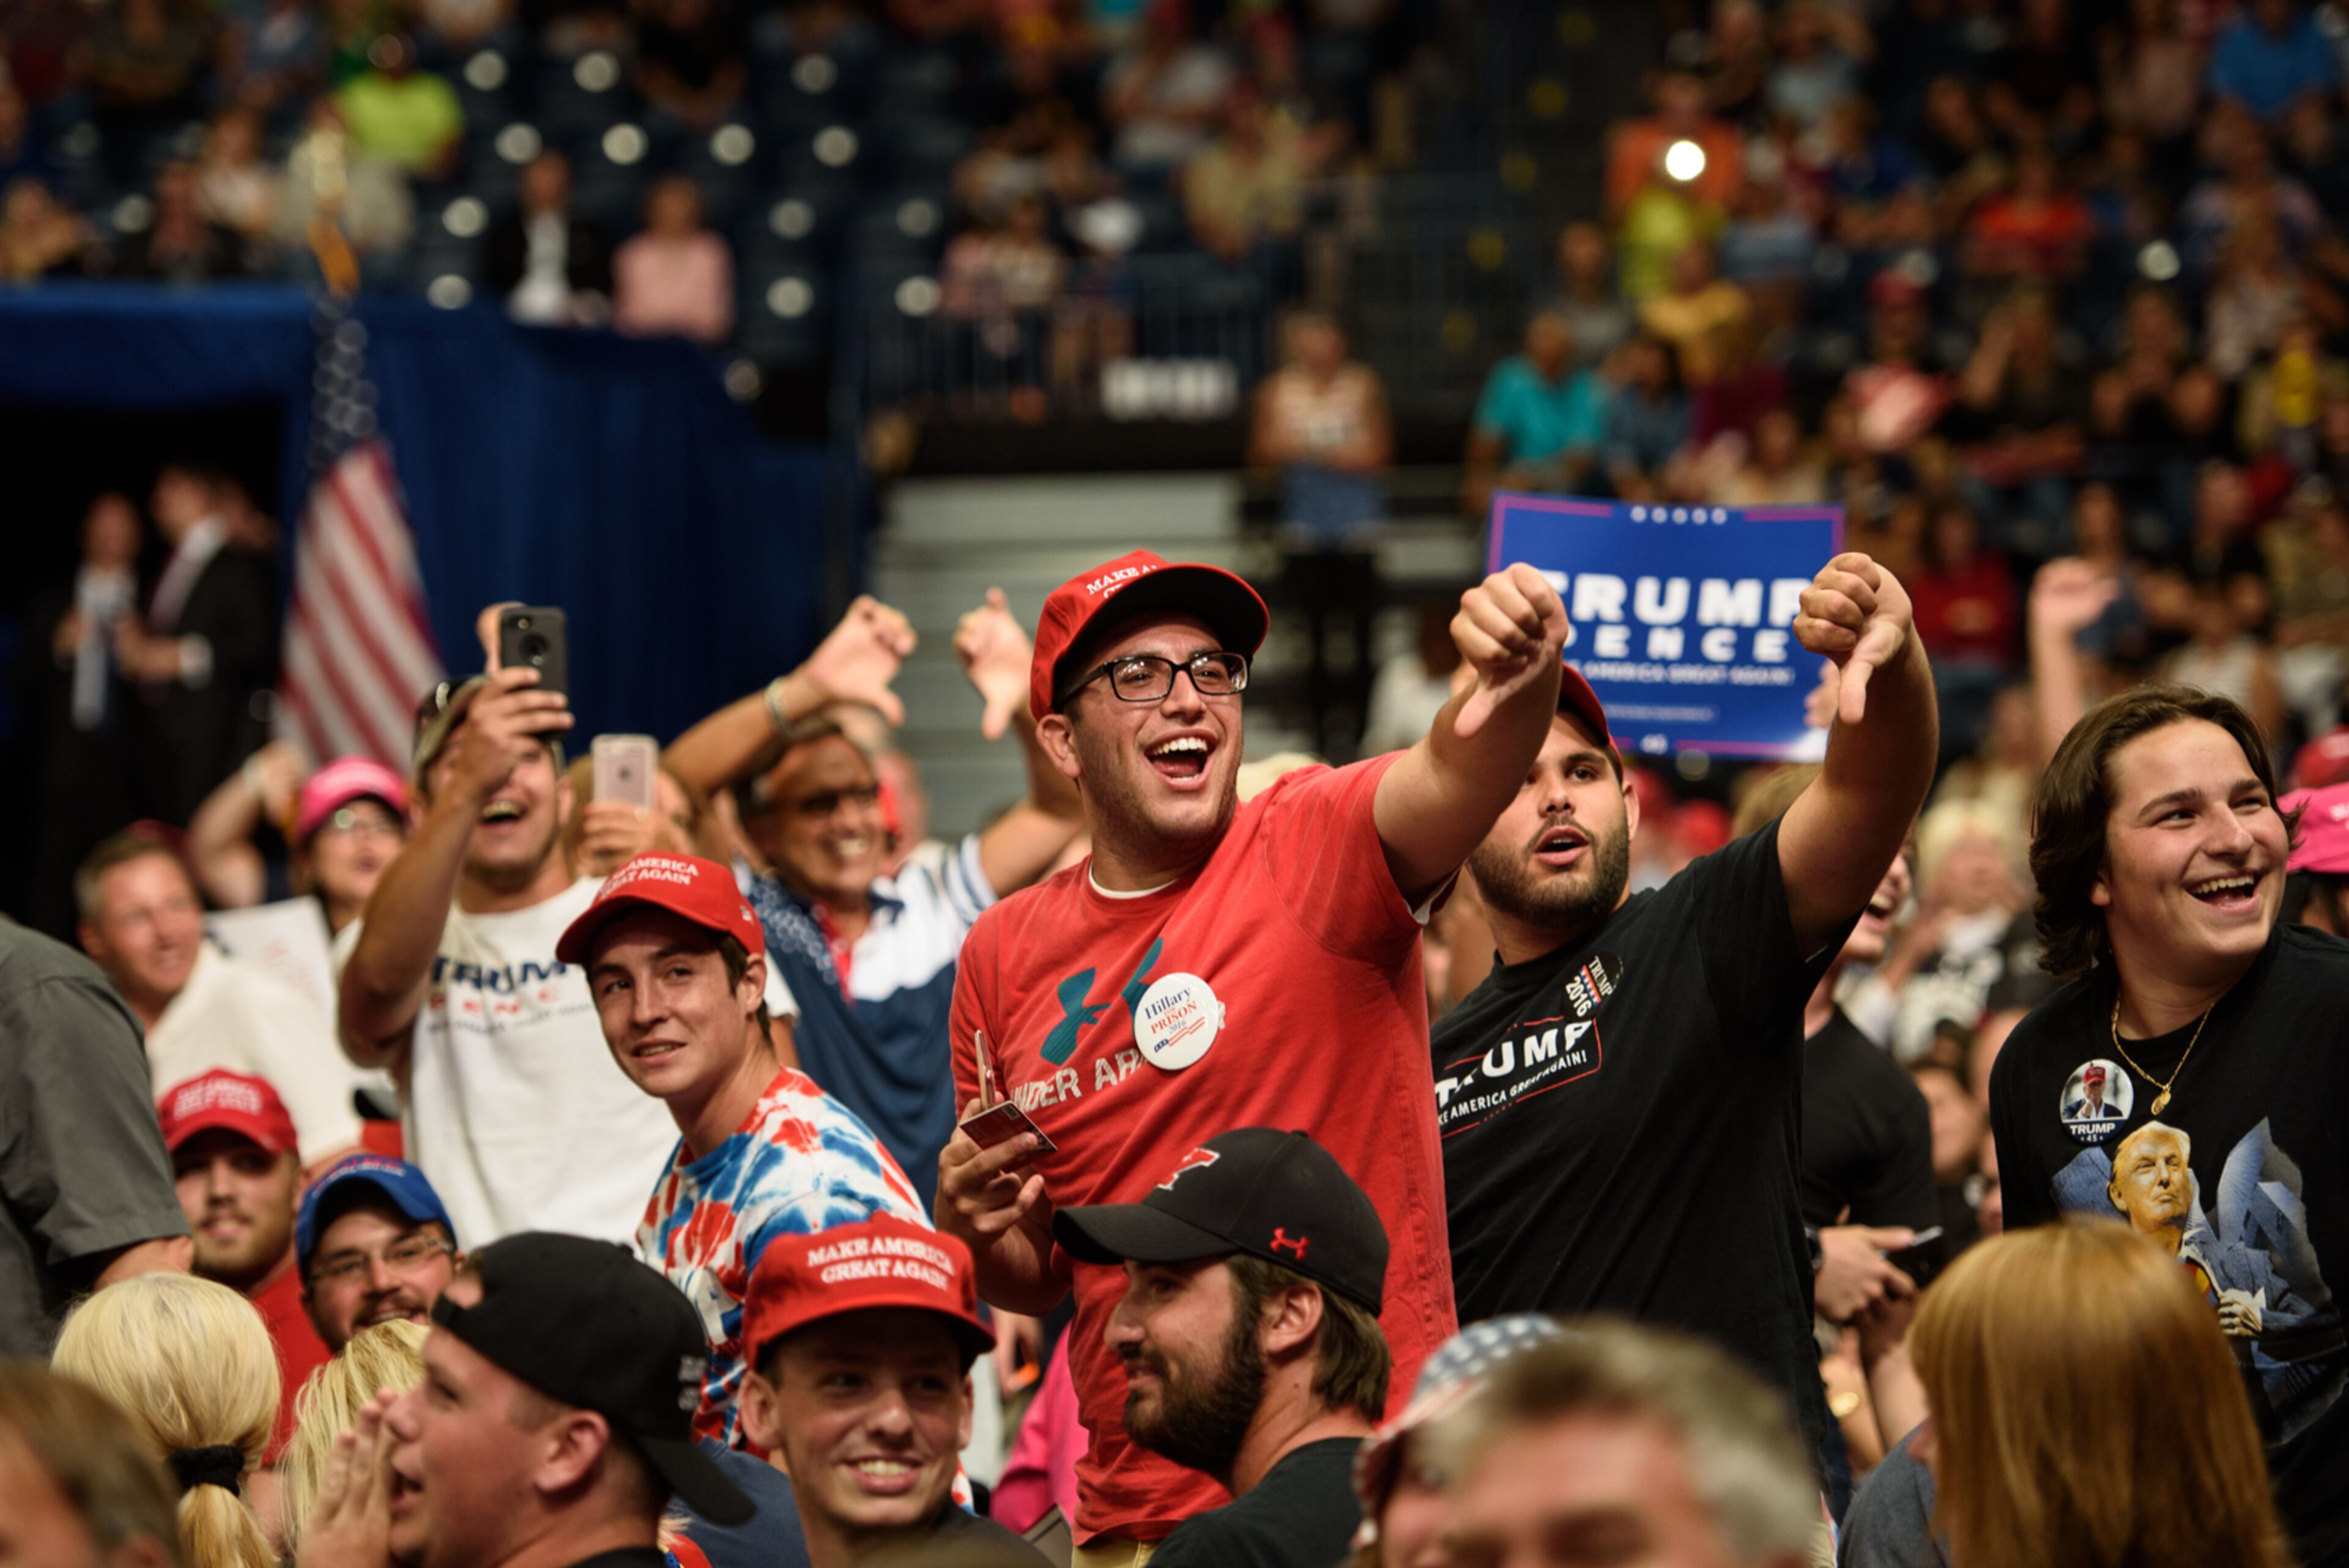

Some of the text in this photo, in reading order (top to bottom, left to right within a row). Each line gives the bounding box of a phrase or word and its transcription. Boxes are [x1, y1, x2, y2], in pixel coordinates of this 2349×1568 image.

[1086, 567, 1140, 595] MAKE
[627, 857, 699, 876] AMERICA
[637, 868, 691, 886] AGAIN
[433, 956, 567, 996] TRUM
[1589, 955, 1613, 996] TRUMP
[1145, 987, 1191, 1020] Hillary
[1565, 975, 1592, 1018] 2016
[1150, 1000, 1198, 1035] PRISON
[1450, 1090, 1507, 1120] AMERICA
[2069, 1123, 2116, 1136] TRUMP
[807, 1237, 956, 1276] MAKE AMERICA
[820, 1258, 948, 1292] GREAT AGAIN
